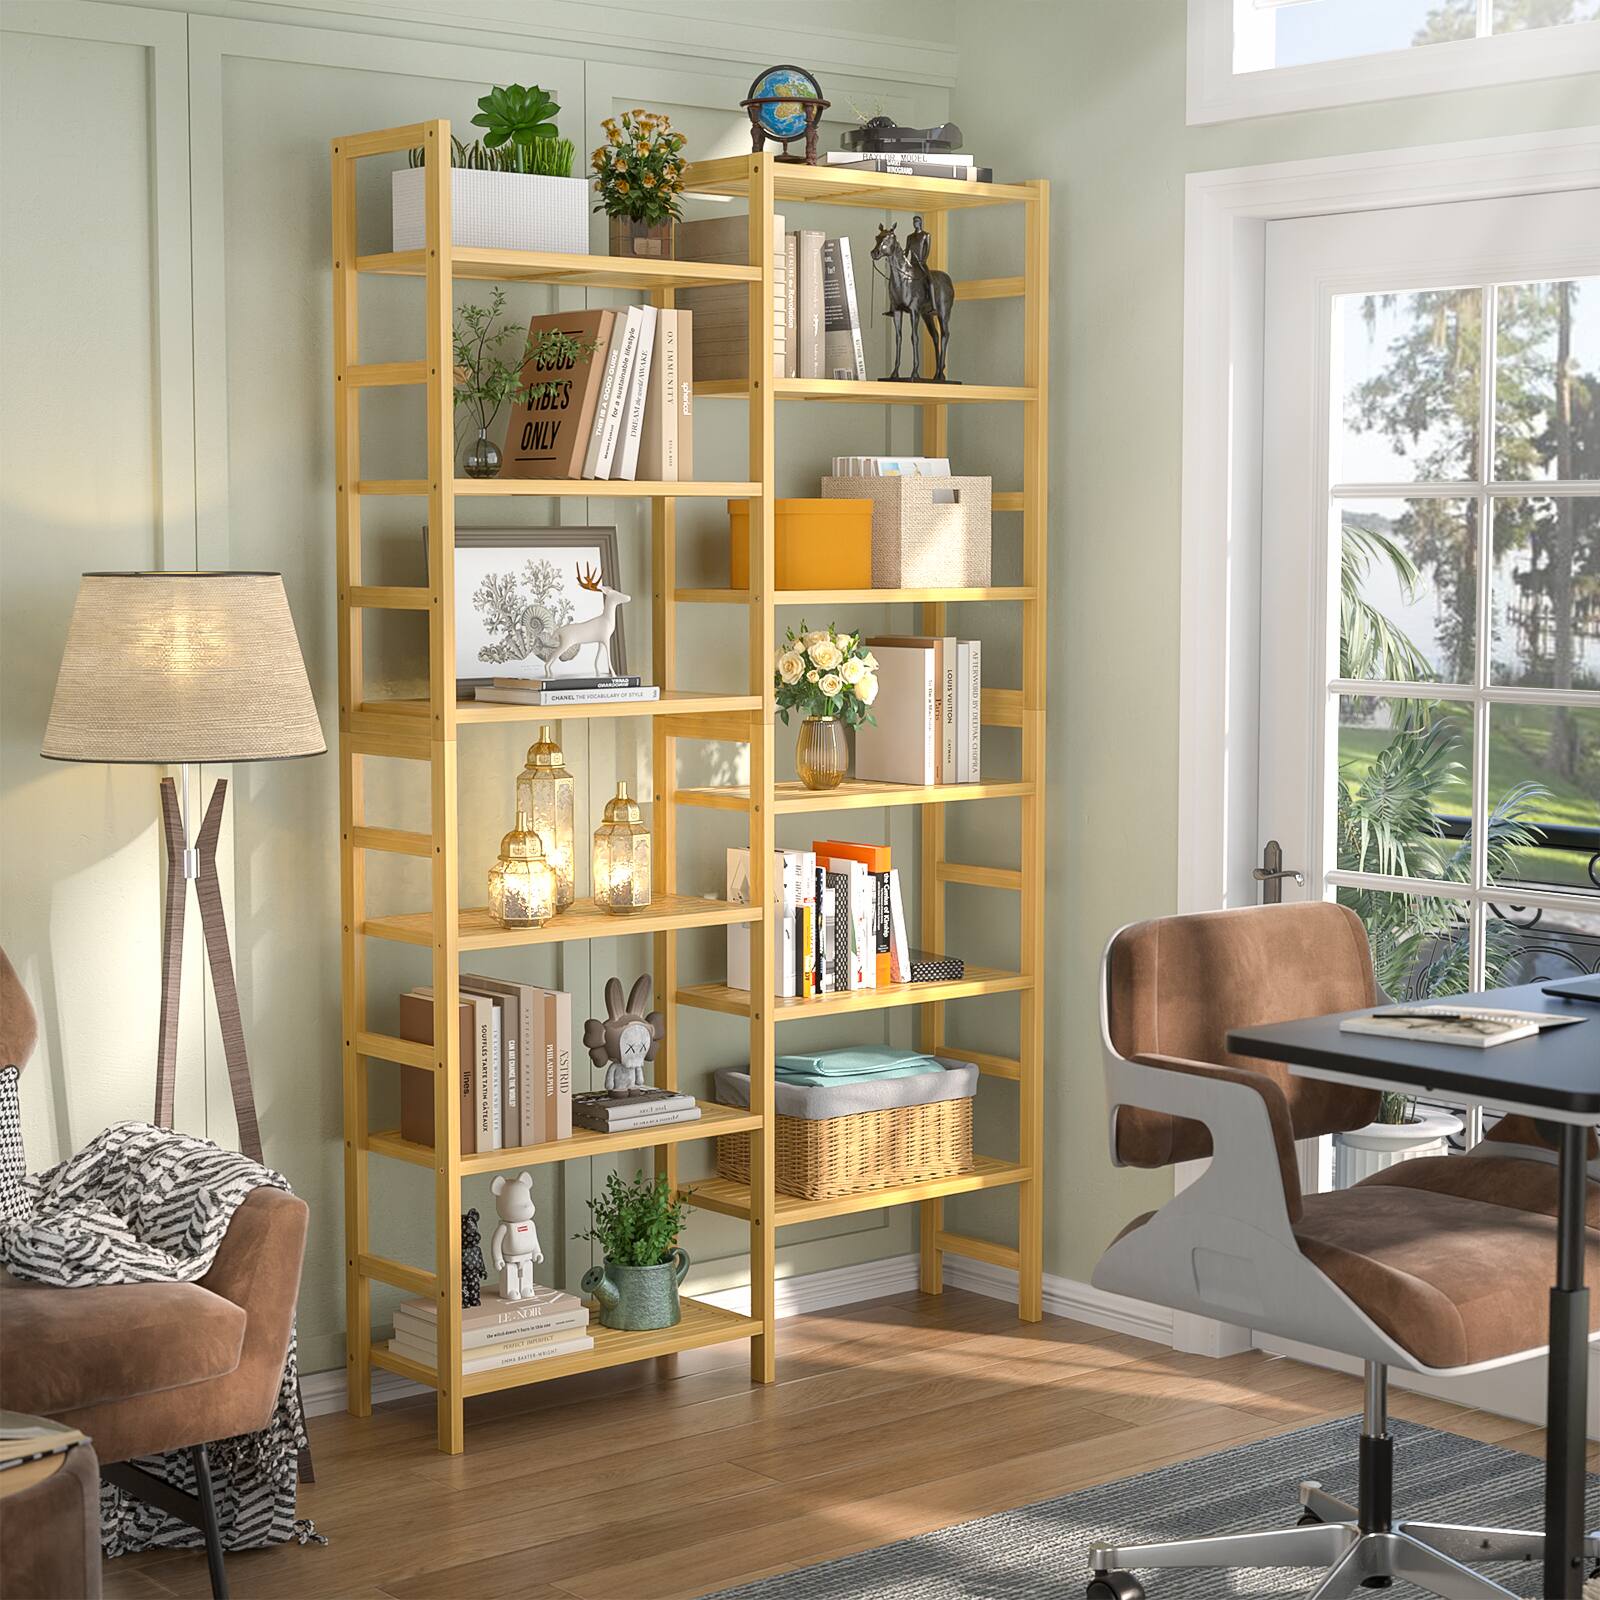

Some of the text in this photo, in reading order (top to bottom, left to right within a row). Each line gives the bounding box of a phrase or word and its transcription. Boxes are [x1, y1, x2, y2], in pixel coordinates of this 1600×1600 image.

[667, 331, 674, 344] ON
[616, 358, 629, 400] sustainable
[624, 328, 635, 357] lifestyle
[527, 380, 572, 411] VIBES
[597, 417, 605, 435] THIS
[608, 350, 618, 374] GUIDE
[631, 407, 640, 436] DREAM
[638, 351, 647, 380] AWAKE
[681, 382, 692, 416] spherical
[520, 420, 562, 450] ONLY
[972, 701, 979, 710] BY
[560, 1050, 568, 1093] ASTRID
